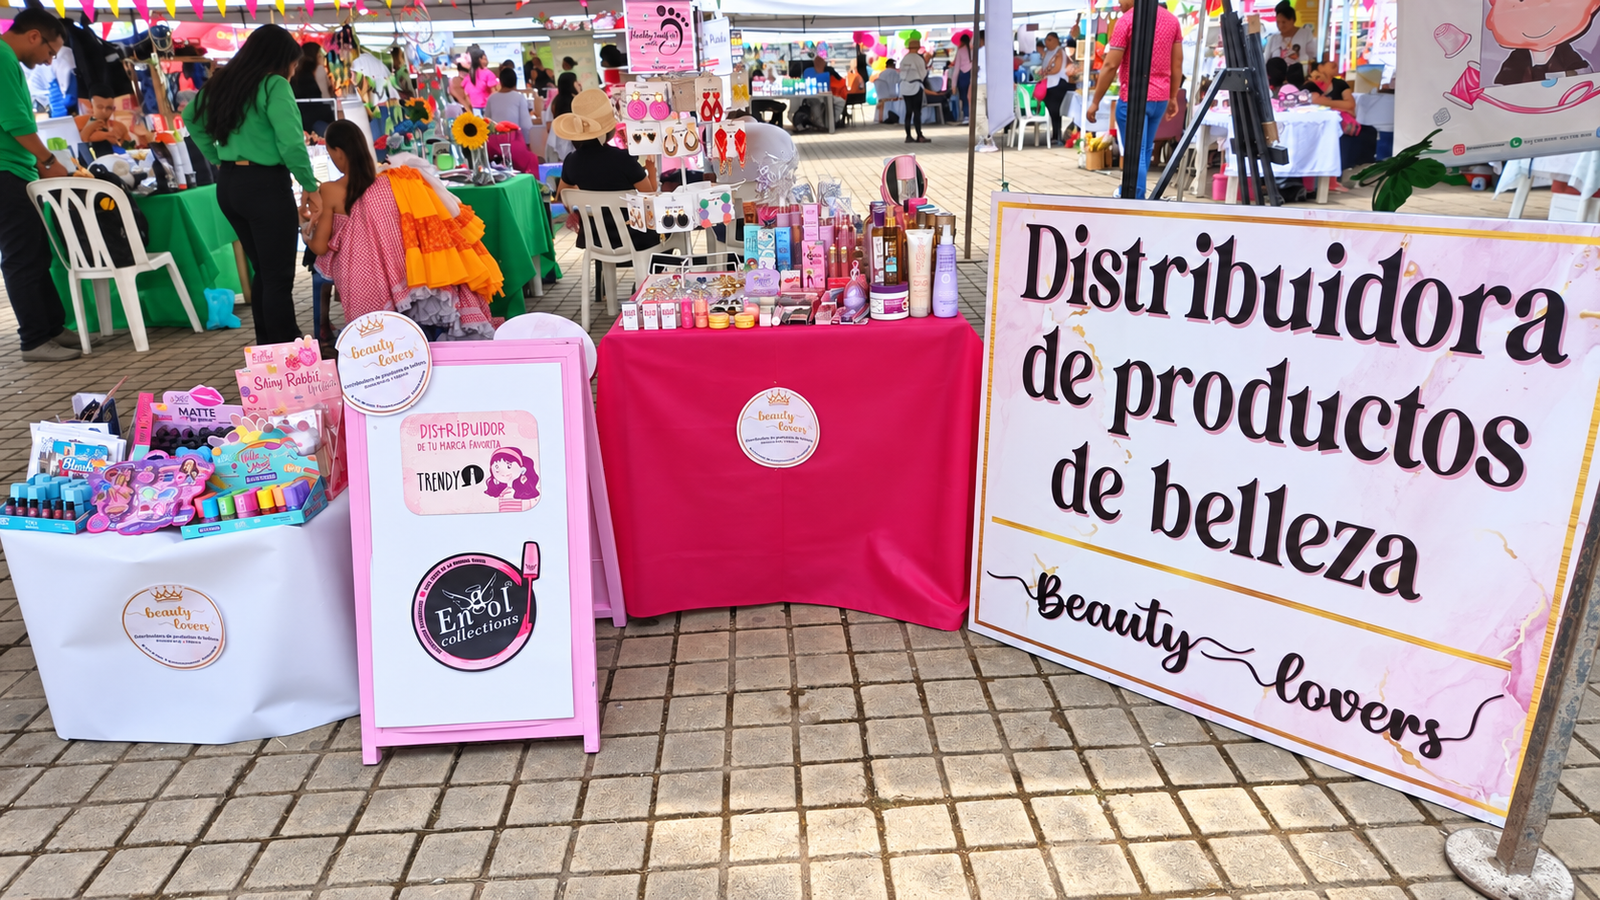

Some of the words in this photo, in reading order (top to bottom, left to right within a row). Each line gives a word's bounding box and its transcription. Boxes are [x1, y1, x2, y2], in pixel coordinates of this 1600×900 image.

[1020, 223, 1571, 368] Distribuidora
[351, 338, 394, 359] beauty
[378, 349, 414, 367] lovers
[254, 376, 283, 391] Shiny
[178, 407, 216, 418] MATTE
[758, 410, 794, 424] beauty
[1021, 325, 1096, 407] de
[1107, 357, 1532, 492] productos
[417, 443, 426, 451] DE
[428, 441, 438, 451] TU
[469, 439, 501, 450] FAVORITA
[417, 470, 460, 492] TRENDY
[1050, 440, 1125, 523] de
[1150, 459, 1423, 603] belleza
[145, 606, 191, 621] beauty
[435, 584, 513, 635] Engol
[173, 618, 210, 632] lovers
[441, 614, 519, 648] collections
[1005, 571, 1228, 675] Beauty
[1240, 652, 1475, 760] lovers
